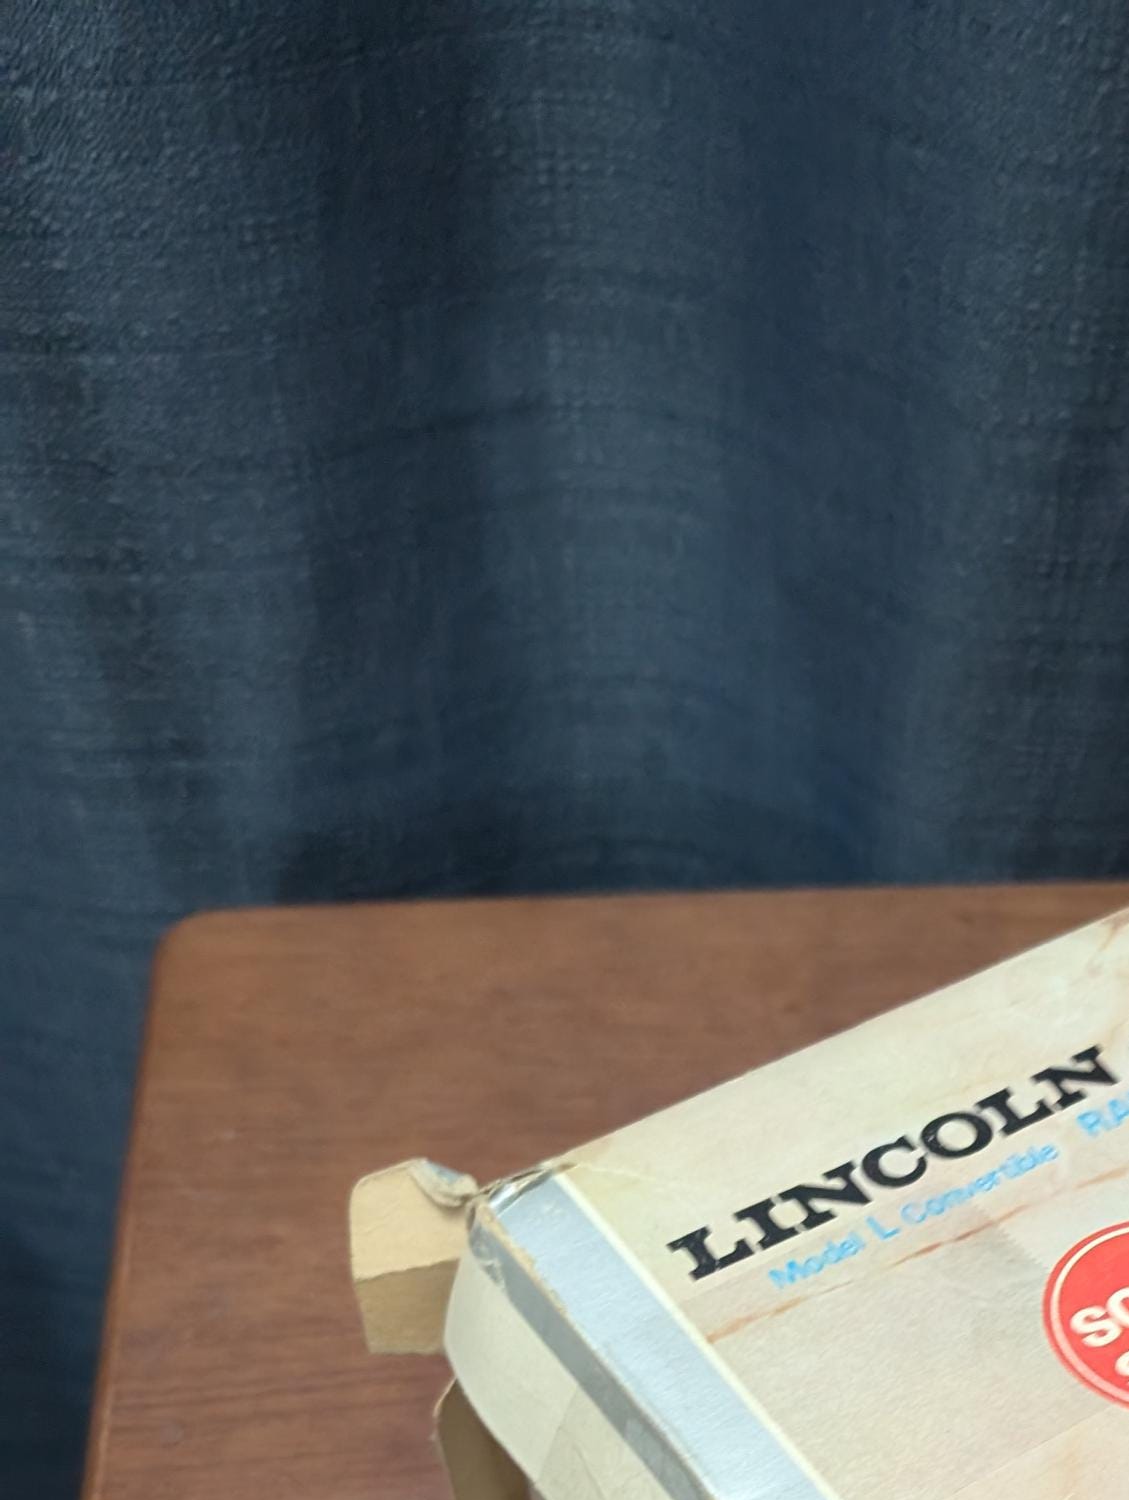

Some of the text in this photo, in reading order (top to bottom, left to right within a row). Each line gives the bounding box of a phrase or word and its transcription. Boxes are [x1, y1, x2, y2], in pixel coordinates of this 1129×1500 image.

[667, 1046, 1120, 1281] LINCOLN
[767, 1237, 864, 1290] Model
[867, 1214, 899, 1242] L
[901, 1142, 1060, 1227] Convertible
